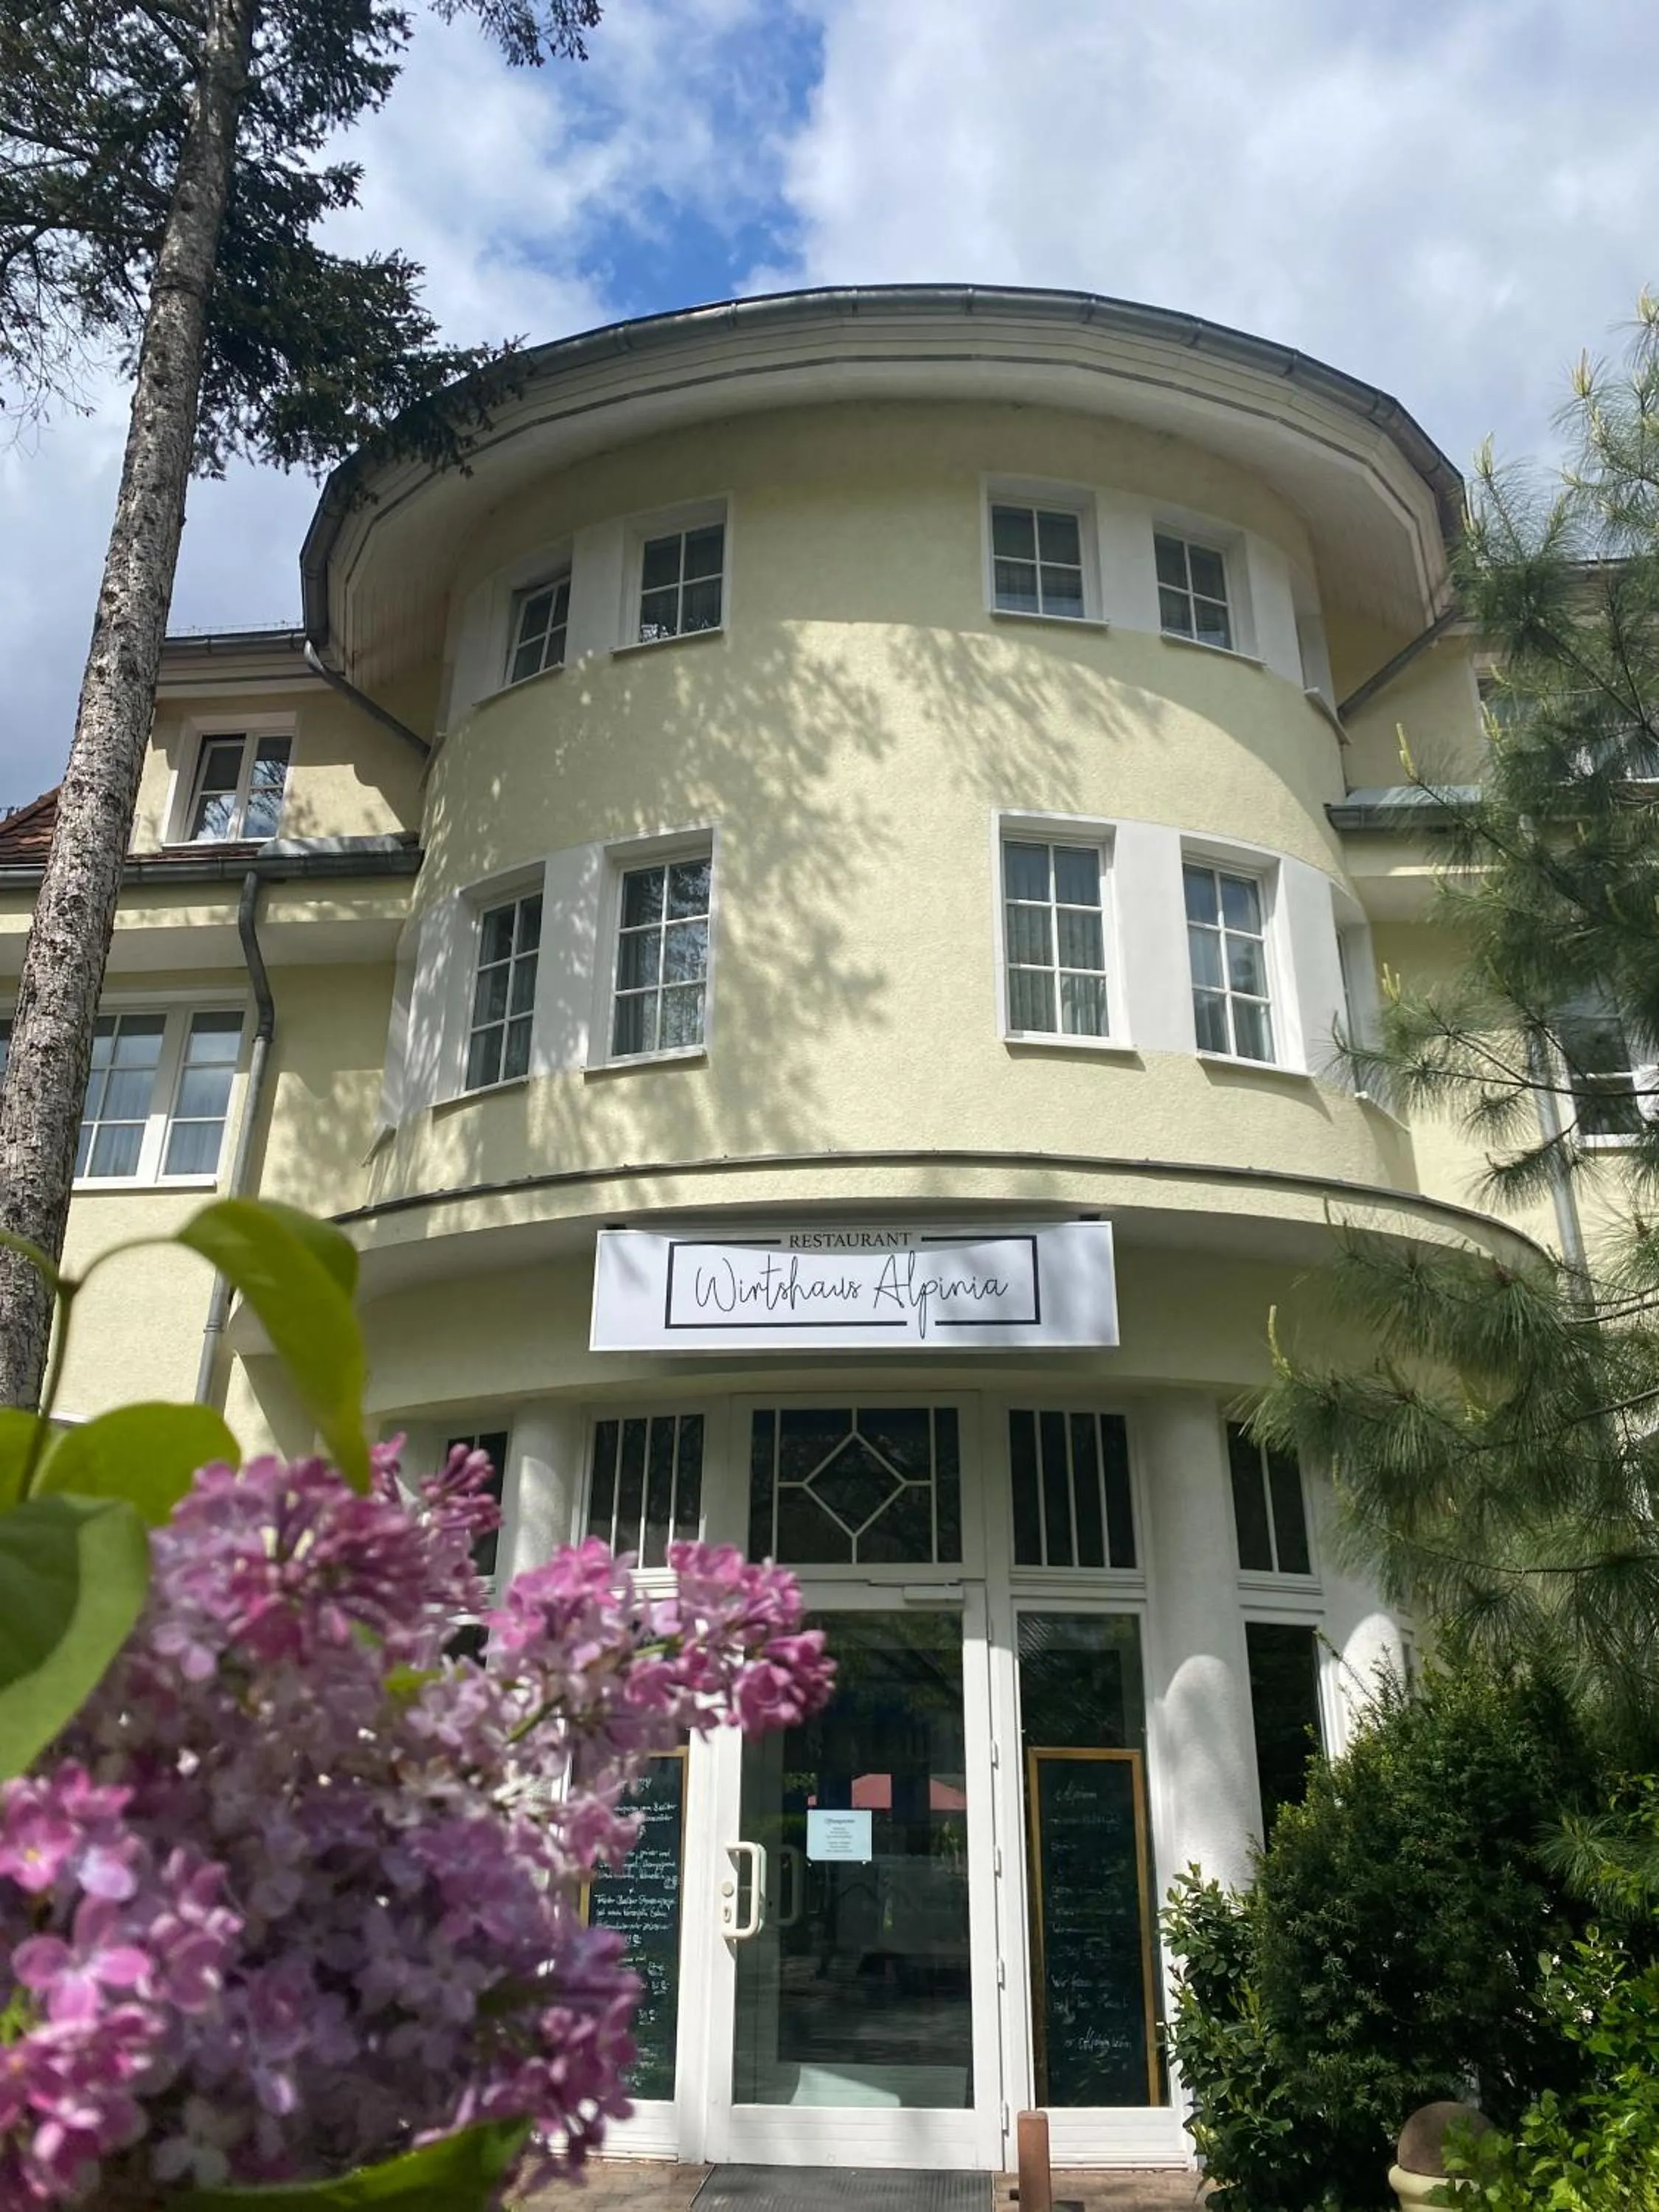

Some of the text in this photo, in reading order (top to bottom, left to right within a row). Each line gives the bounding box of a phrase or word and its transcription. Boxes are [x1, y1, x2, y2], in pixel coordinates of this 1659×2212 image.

[788, 1231, 913, 1249] RESTAURANT
[695, 1251, 1009, 1340] Wirtshaus Alpinia
